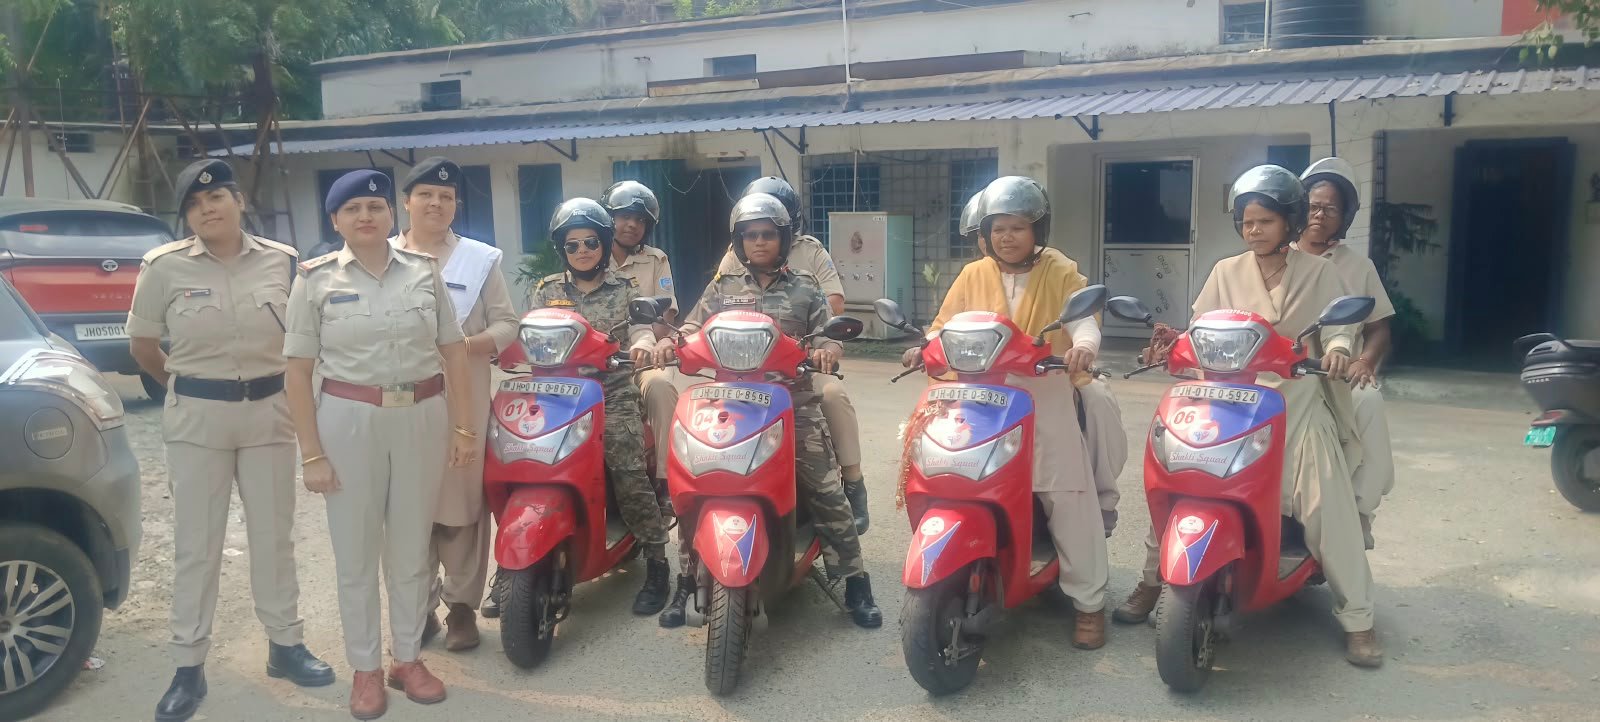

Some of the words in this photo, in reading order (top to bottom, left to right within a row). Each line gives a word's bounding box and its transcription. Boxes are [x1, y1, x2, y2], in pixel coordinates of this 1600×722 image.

[505, 402, 524, 417] 01
[694, 412, 714, 427] 04
[1173, 410, 1196, 424] 06
[527, 443, 555, 454] Squad
[720, 452, 747, 464] Squad
[951, 456, 980, 468] Squad
[1170, 452, 1194, 462] Shakti
[1196, 453, 1228, 465] Squad
